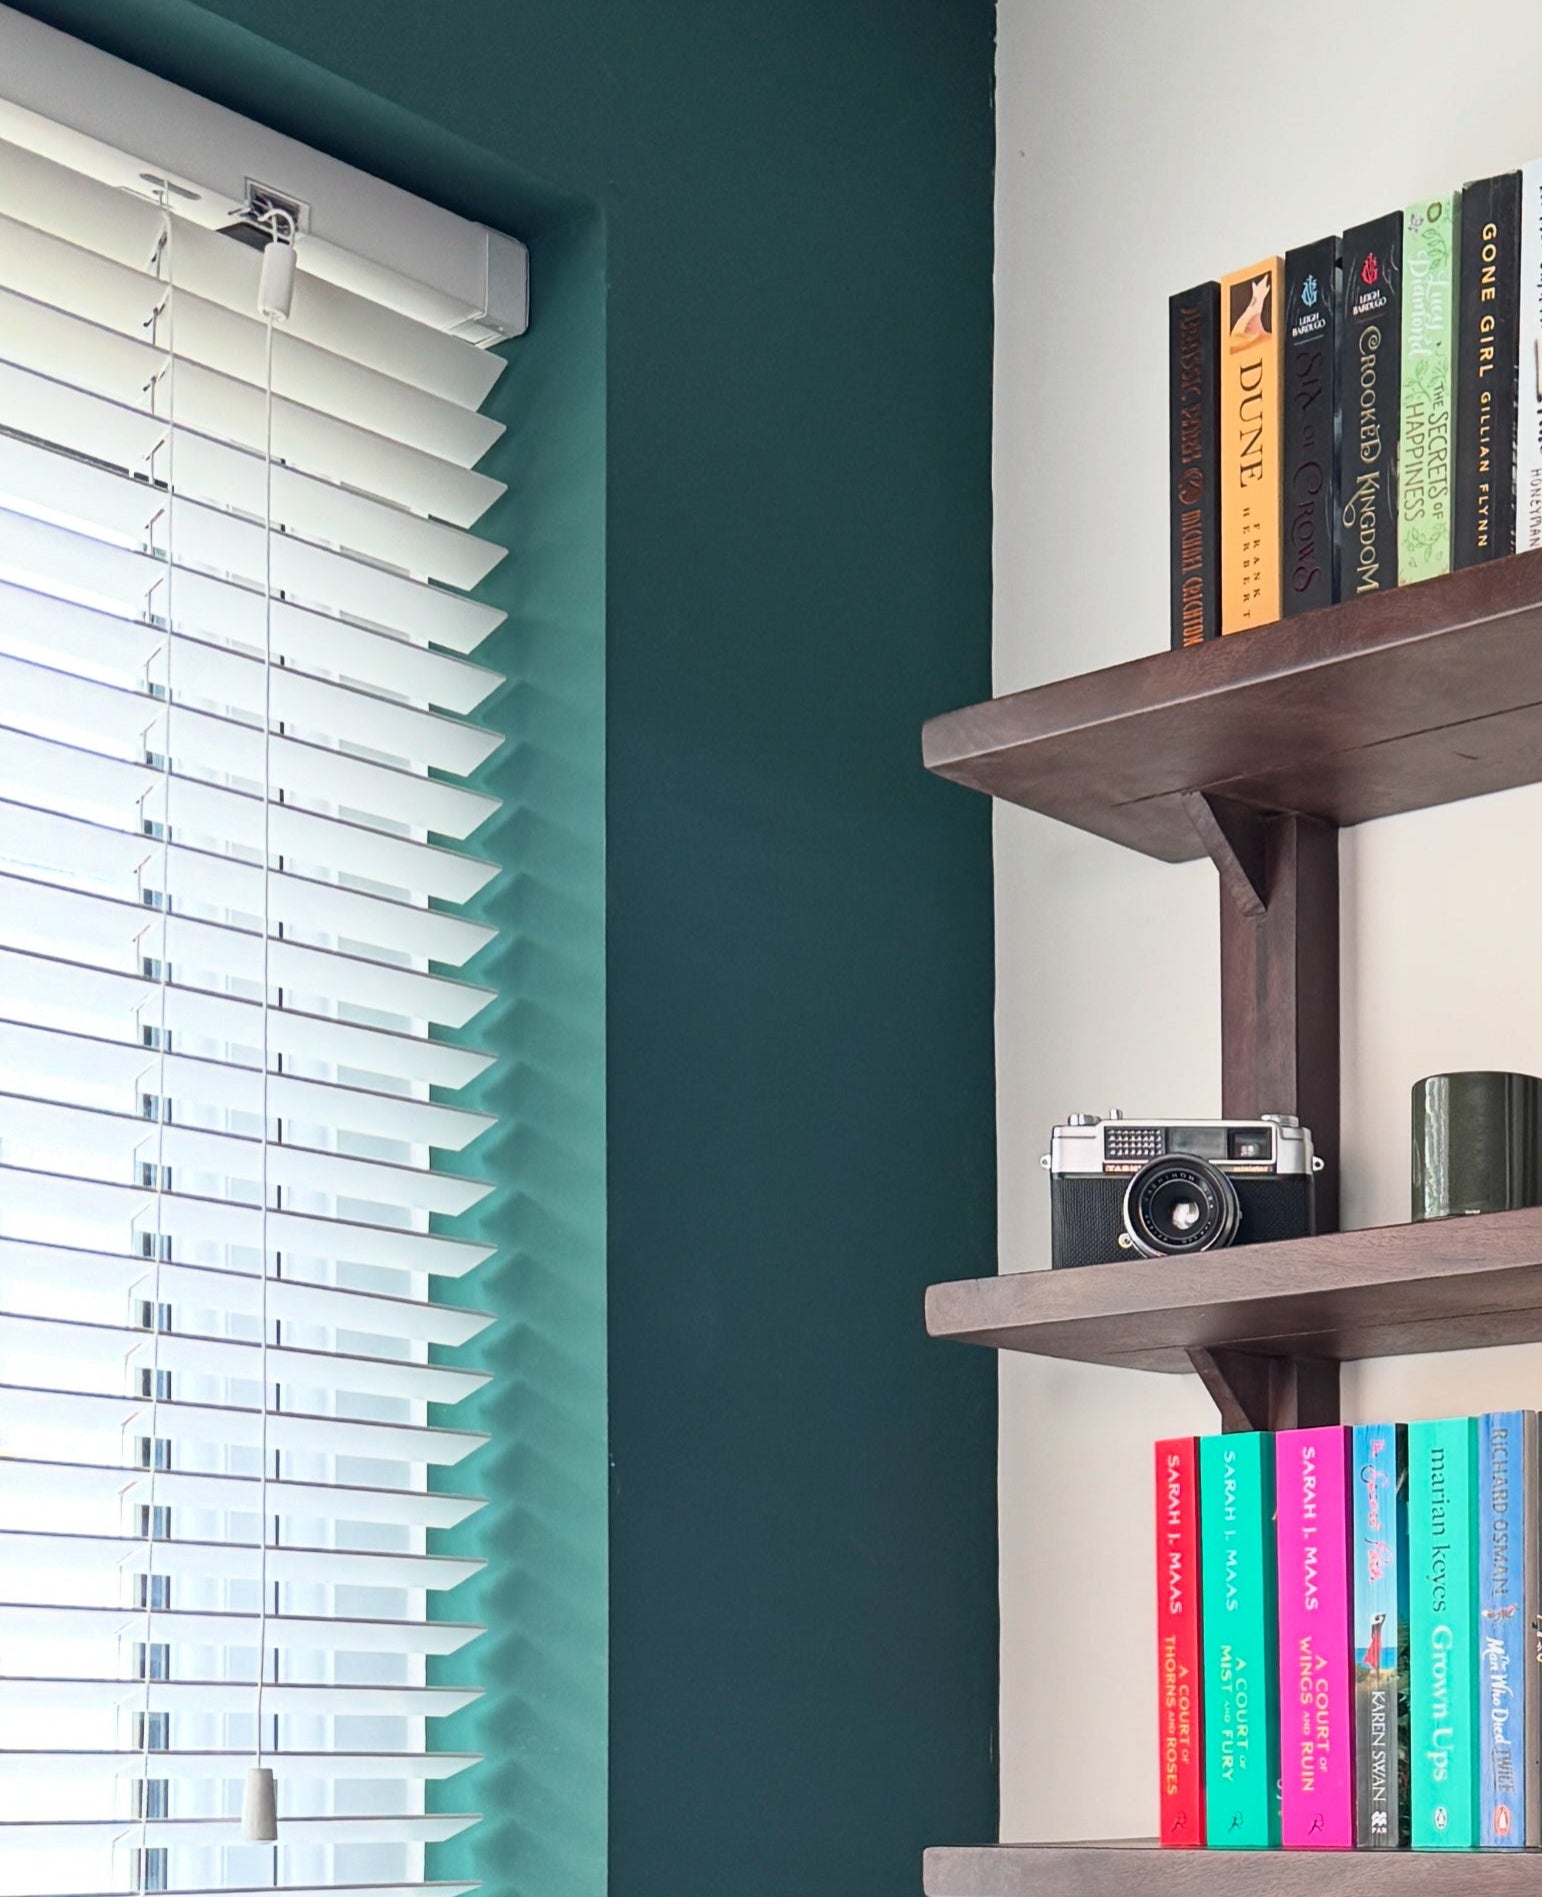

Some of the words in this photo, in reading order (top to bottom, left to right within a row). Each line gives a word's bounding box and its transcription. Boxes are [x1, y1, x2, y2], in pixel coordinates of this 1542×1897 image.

[1480, 222, 1498, 303] GONE
[1291, 318, 1327, 338] BARDUGO
[1299, 312, 1320, 327] LEIGH
[1352, 295, 1388, 317] BARDUGO
[1359, 289, 1381, 305] LEIGH
[1408, 252, 1433, 357] Diamond
[1425, 270, 1450, 331] Lucy
[1478, 315, 1495, 379] GIRL
[1239, 357, 1263, 489] DUNE
[1359, 325, 1382, 464] CROOKED
[1432, 379, 1445, 410] THE
[1404, 401, 1425, 522] HAPPINESS
[1427, 410, 1449, 500] SECRETS
[1478, 391, 1492, 473] GILLIAN
[1343, 471, 1381, 595] KINGDOM
[1432, 502, 1444, 520] OF
[1477, 483, 1490, 548] FLYNN
[1529, 467, 1542, 547] HONEYMAN
[1181, 509, 1203, 574] MICHAEL
[1242, 506, 1251, 619] HERBERT
[1253, 523, 1261, 599] FRANK
[1182, 576, 1204, 648] CRICHTON
[1167, 1454, 1182, 1525] SARAH
[1223, 1450, 1237, 1521] SARAH
[1302, 1446, 1317, 1519] SARAH
[1431, 1448, 1450, 1536] marian
[1491, 1427, 1509, 1515] RICHARD
[1168, 1552, 1183, 1615] MAAS
[1225, 1549, 1239, 1612] MAAS
[1304, 1547, 1319, 1611] MAAS
[1426, 1544, 1451, 1613] keyes
[1491, 1518, 1509, 1596] OSMAN
[1163, 1635, 1177, 1708] THORNS
[1178, 1664, 1190, 1678] A
[1220, 1645, 1233, 1693] MIST
[1234, 1656, 1248, 1671] A
[1299, 1636, 1314, 1705] WINGS
[1314, 1656, 1328, 1670] A
[1430, 1624, 1454, 1720] Grown
[1481, 1637, 1505, 1675] Man
[1178, 1684, 1190, 1746] COURT
[1234, 1678, 1249, 1750] COURT
[1314, 1679, 1330, 1753] COURT
[1371, 1691, 1386, 1747] KAREN
[1490, 1674, 1514, 1707] Who
[1221, 1729, 1234, 1782] FURY
[1425, 1727, 1455, 1782] Ups
[1490, 1708, 1512, 1745] Died
[1166, 1737, 1178, 1796] ROSES
[1300, 1741, 1315, 1792] RUIN
[1371, 1750, 1387, 1802] SWAN
[1495, 1748, 1515, 1793] TWICE
